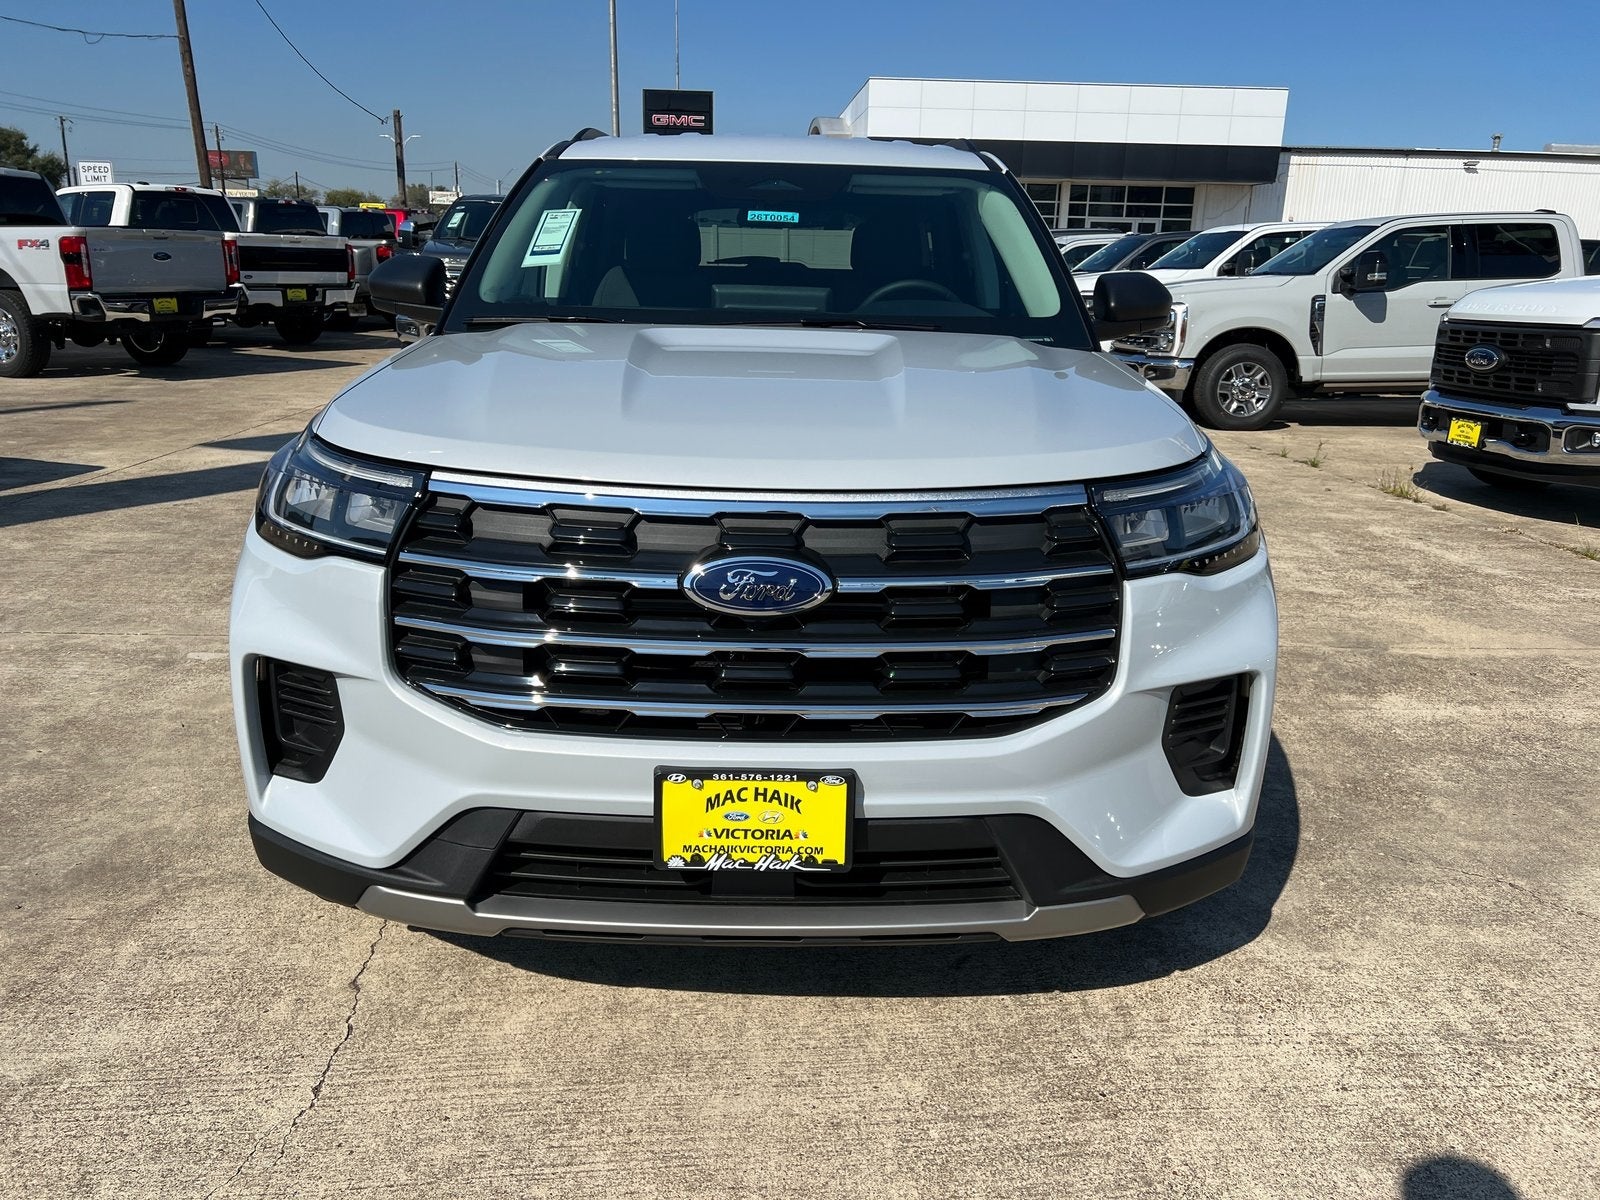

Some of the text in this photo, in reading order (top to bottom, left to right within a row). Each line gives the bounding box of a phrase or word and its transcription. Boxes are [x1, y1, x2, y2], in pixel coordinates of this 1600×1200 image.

[651, 114, 705, 127] GMC
[81, 165, 110, 174] SPEED
[85, 175, 107, 183] LIMIT
[749, 213, 796, 222] 26T0054
[17, 239, 50, 250] FX4
[718, 568, 798, 601] Ford
[712, 773, 798, 782] 361-576-1221
[705, 787, 802, 815] MAC HAIK
[712, 828, 794, 840] VICTORIA
[682, 844, 824, 856] MACHAIKVICTORIA.COM
[704, 853, 805, 871] Mac Haik
